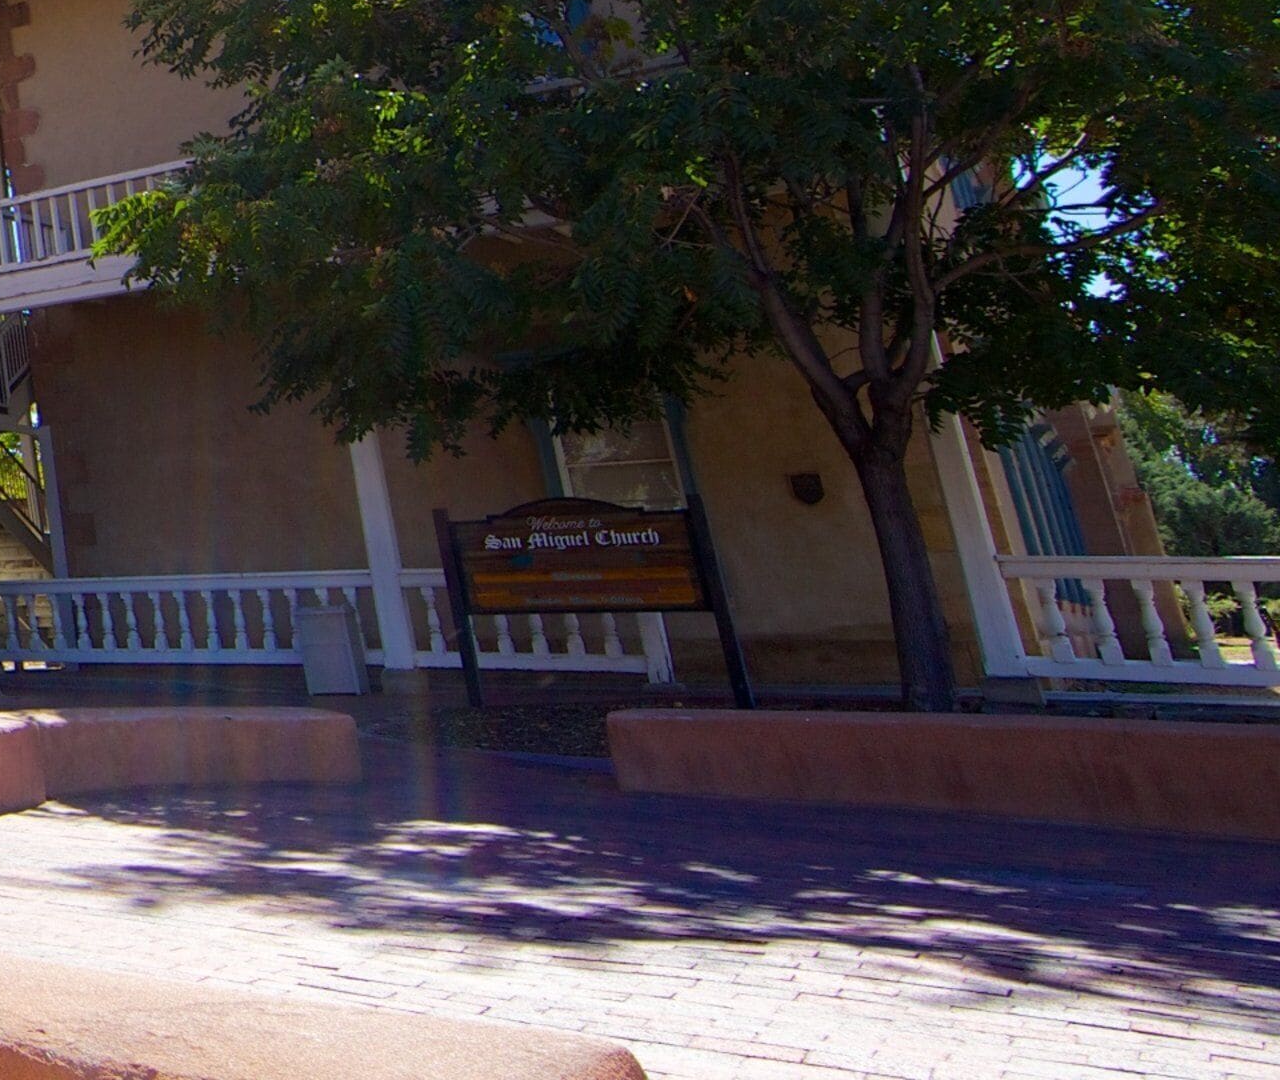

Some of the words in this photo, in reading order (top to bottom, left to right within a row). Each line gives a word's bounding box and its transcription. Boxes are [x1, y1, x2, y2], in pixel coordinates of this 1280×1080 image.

[526, 516, 585, 531] Welcome
[589, 517, 602, 528] to
[484, 534, 523, 551] San
[526, 531, 590, 550] Miguel
[595, 528, 660, 548] Church
